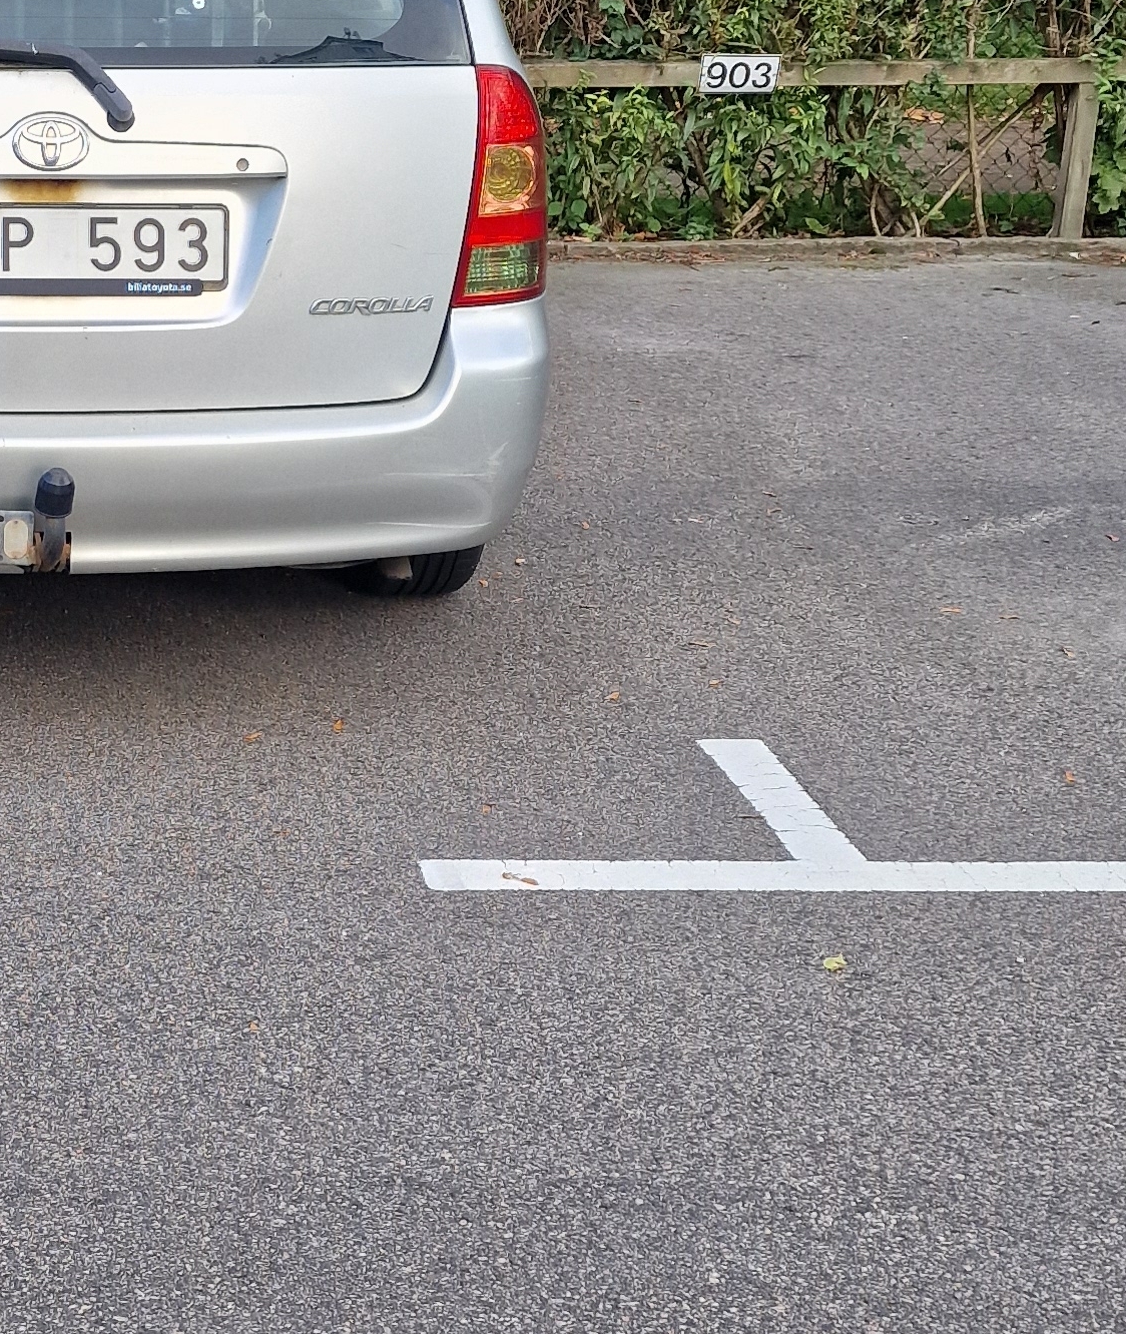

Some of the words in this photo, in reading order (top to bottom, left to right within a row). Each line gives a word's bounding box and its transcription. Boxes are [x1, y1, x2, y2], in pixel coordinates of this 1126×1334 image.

[706, 62, 772, 88] 903
[89, 217, 209, 272] 593
[127, 281, 192, 293] biliatoyota.se
[309, 294, 434, 316] COROLLA
